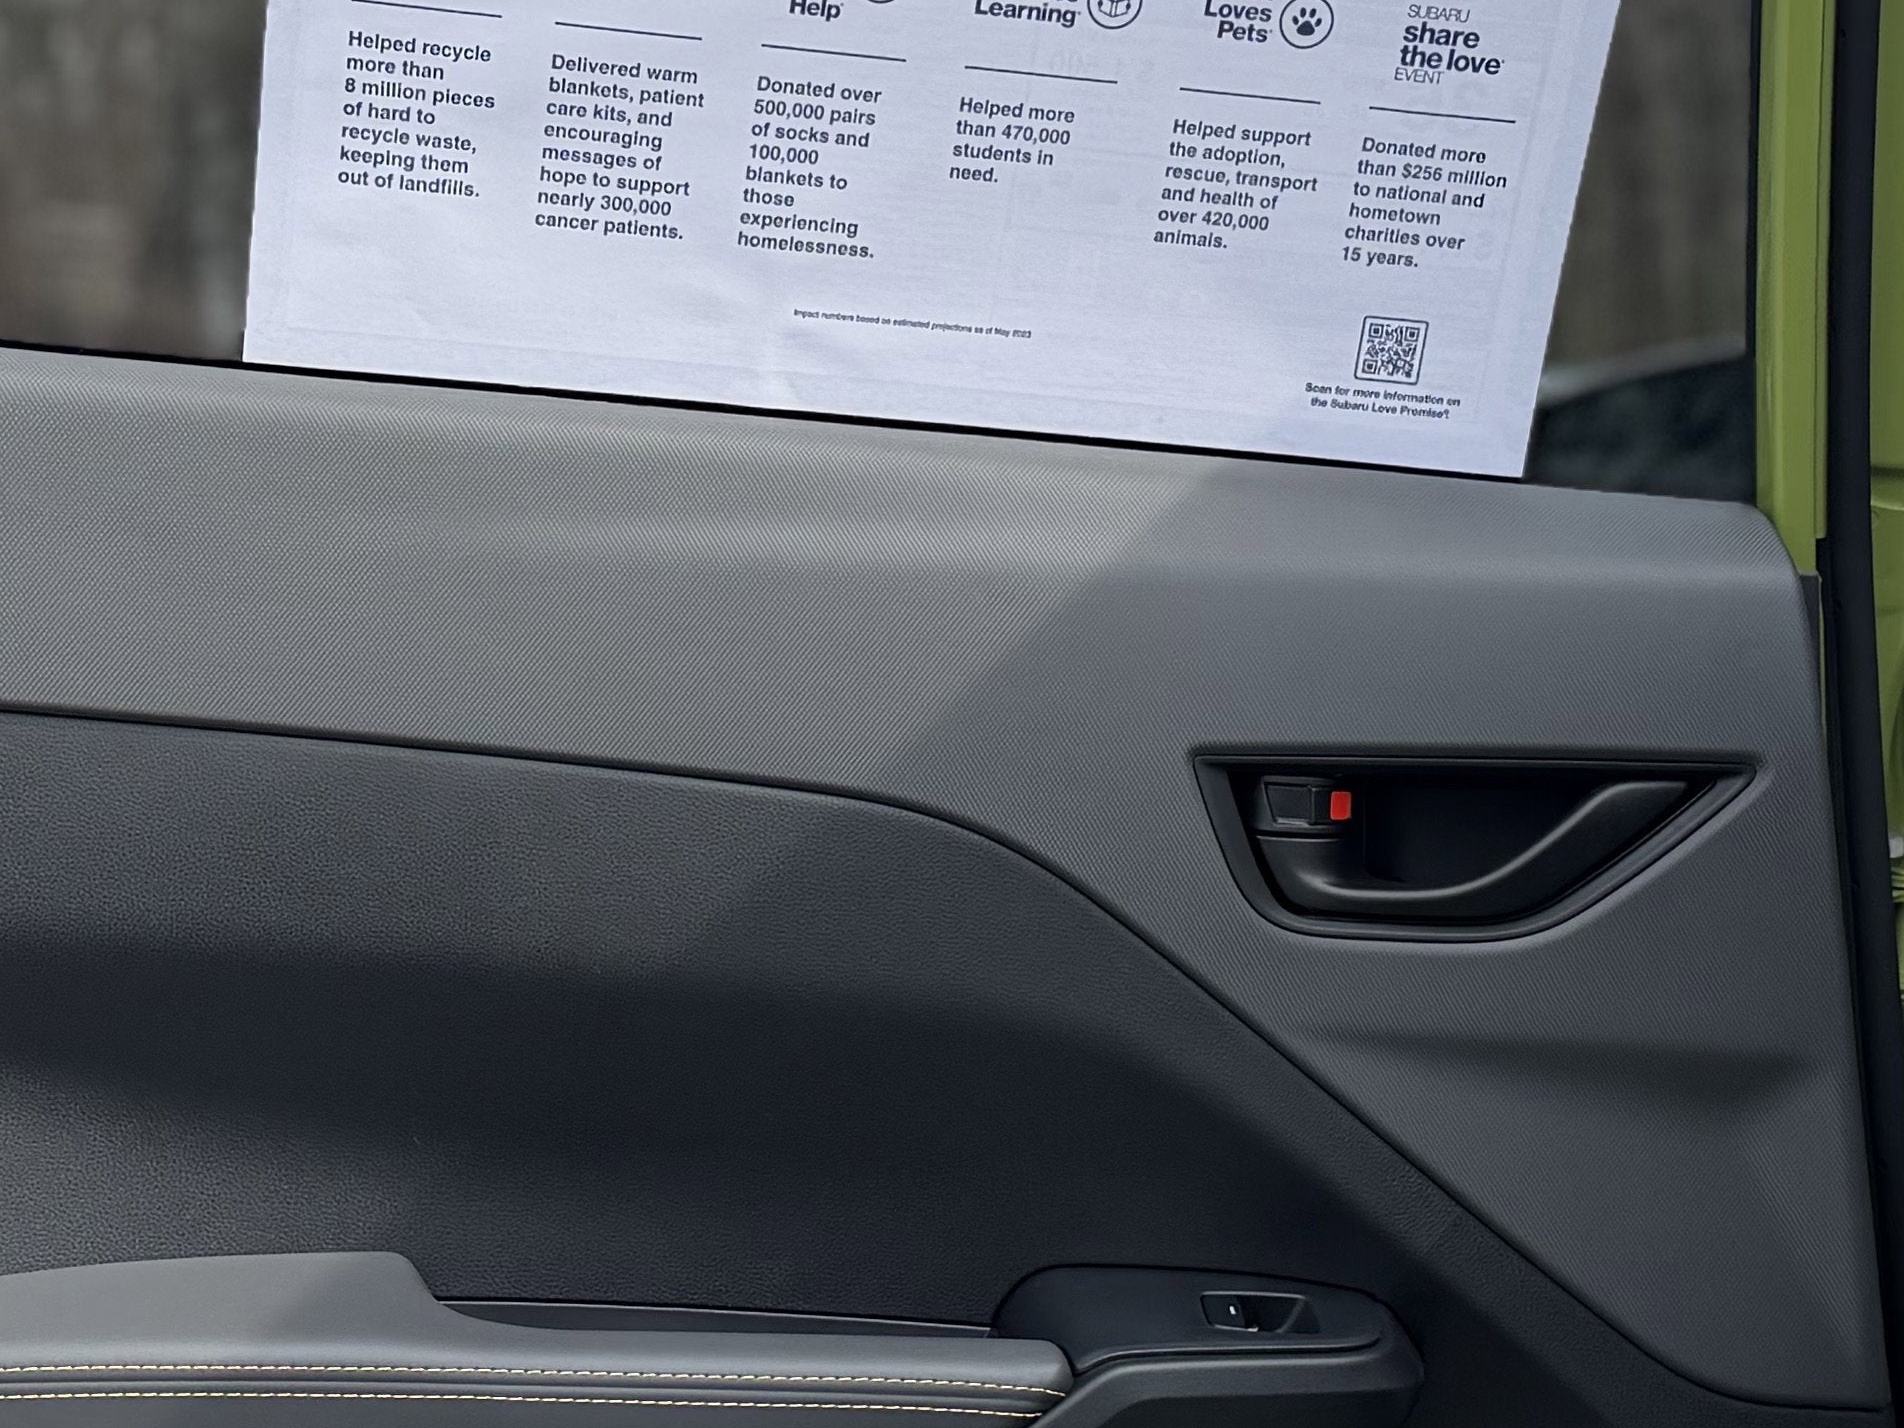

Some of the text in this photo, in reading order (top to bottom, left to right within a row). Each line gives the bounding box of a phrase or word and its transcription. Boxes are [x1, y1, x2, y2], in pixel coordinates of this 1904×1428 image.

[1408, 4, 1470, 23] SUBARU
[348, 31, 491, 62] Helped recycle
[1403, 21, 1480, 49] share
[347, 58, 444, 80] more than
[551, 54, 697, 84] Delivered warm
[1400, 44, 1443, 69] the
[1394, 67, 1444, 85] EVENT
[345, 77, 495, 108] 8 million pieces
[549, 77, 704, 108] blankets, patient
[757, 76, 882, 103] Donated over
[343, 102, 435, 124] of hard to
[546, 103, 672, 127] care kits, and
[754, 99, 875, 125] 500,000 pairs
[959, 96, 1075, 123] Helped more
[342, 126, 476, 154] recycle waste,
[544, 125, 662, 152] encouraging
[751, 122, 870, 147] of socks and
[956, 120, 1070, 145] than 470,000
[1173, 119, 1312, 147] Helped support
[340, 145, 468, 173] keeping them
[542, 148, 662, 171] messages of
[750, 144, 819, 165] 100,000
[953, 143, 1053, 166] students in
[1170, 141, 1285, 169] the adoption,
[1362, 137, 1486, 163] Donated more
[338, 171, 479, 197] out of landfills.
[540, 165, 690, 196] hope to support
[746, 165, 847, 190] blankets to
[950, 167, 998, 183] need.
[1165, 166, 1318, 192] rescue, transport
[1358, 159, 1507, 188] than $256 million
[538, 192, 671, 216] nearly 300,000
[743, 188, 794, 207] those
[1161, 187, 1279, 210] and health of
[1354, 181, 1486, 208] to national and
[535, 214, 683, 239] cancer patients.
[740, 213, 858, 238] experiencing
[1158, 210, 1269, 231] over 420,000
[1349, 202, 1440, 226] hometown
[738, 231, 874, 258] homelessness.
[1153, 230, 1227, 249] animals.
[1345, 225, 1466, 250] charities over
[1343, 246, 1418, 267] 15 years.
[1305, 382, 1460, 407] Scan for more information on
[1311, 397, 1328, 407] the
[1330, 399, 1369, 411] Subaru
[1372, 402, 1397, 414] Love
